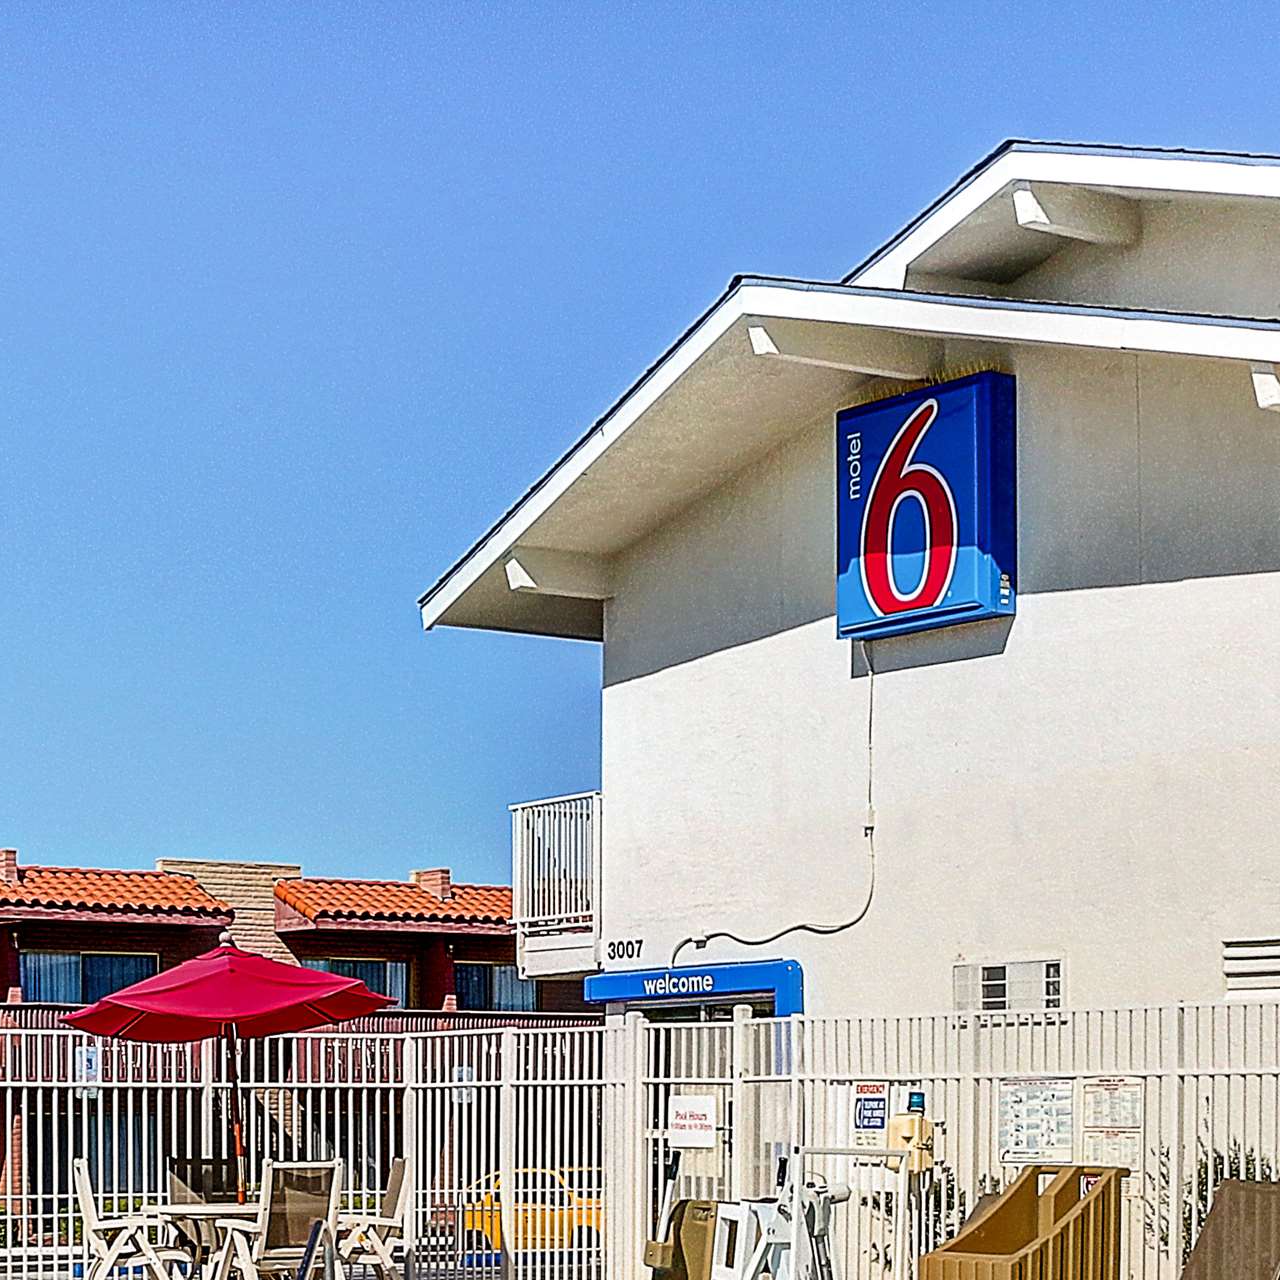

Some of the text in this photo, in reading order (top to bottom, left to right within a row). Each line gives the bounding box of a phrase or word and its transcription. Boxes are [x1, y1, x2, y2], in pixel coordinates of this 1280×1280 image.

[847, 431, 861, 500] motel
[859, 398, 958, 617] 6
[607, 939, 644, 960] 3007
[643, 973, 713, 995] welcome
